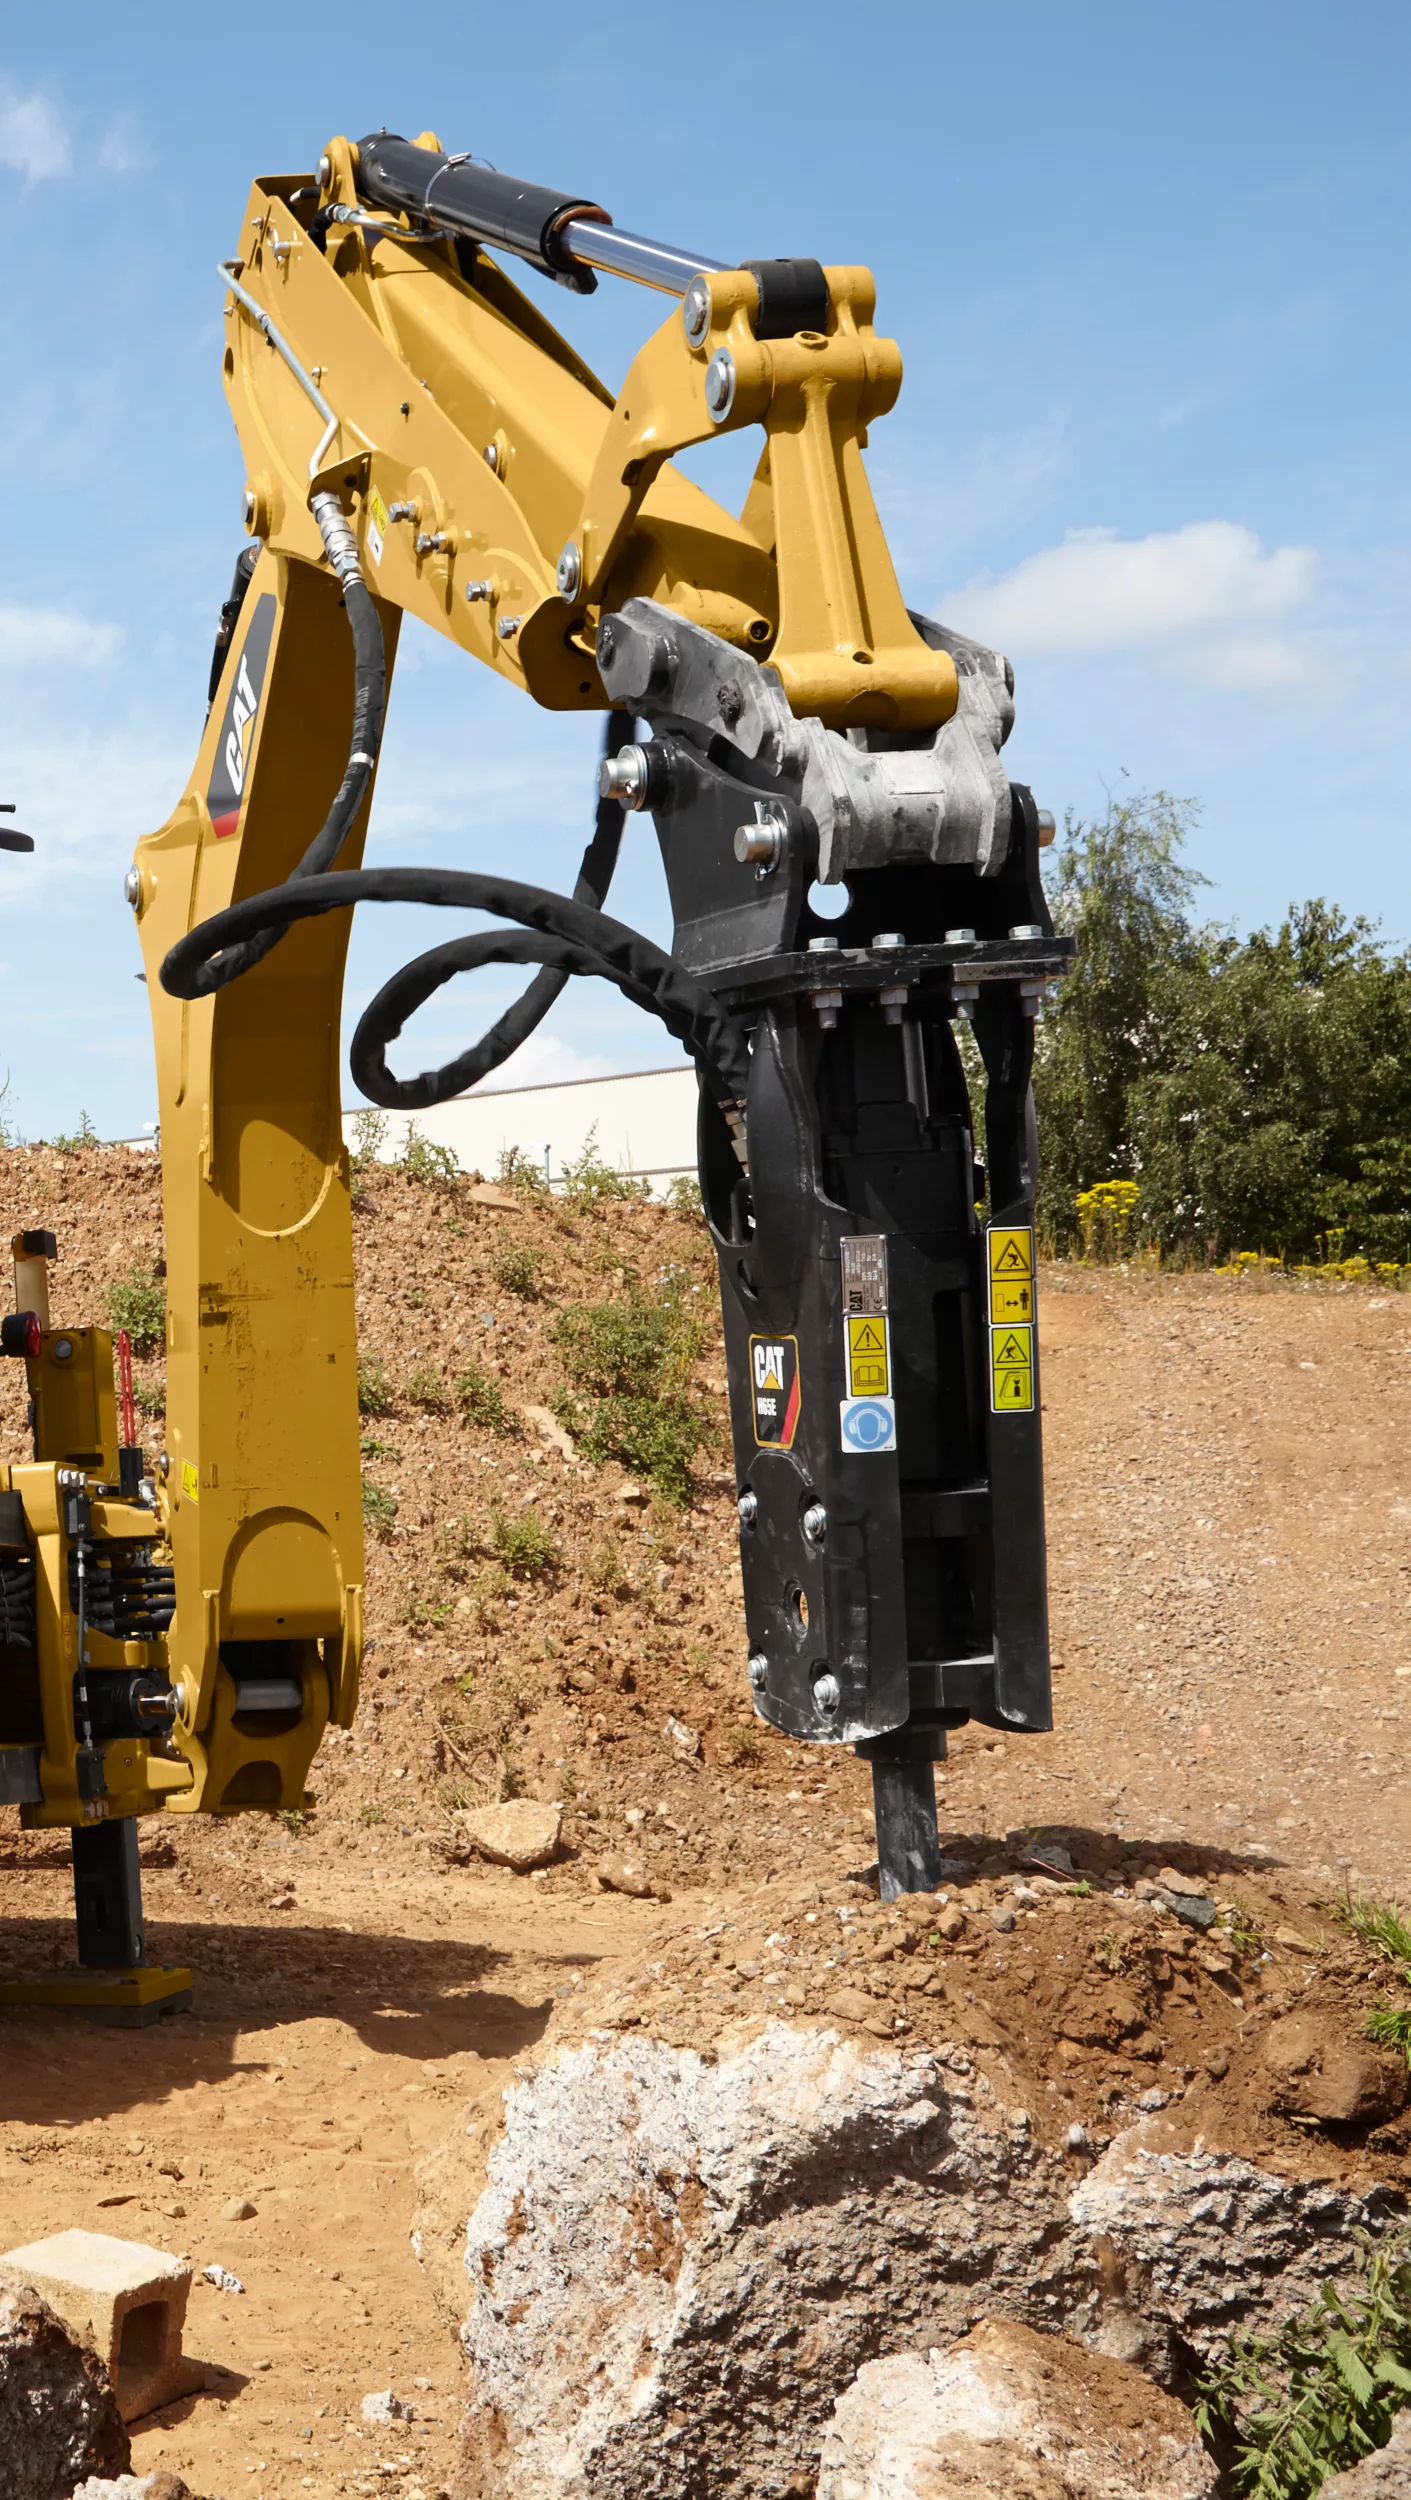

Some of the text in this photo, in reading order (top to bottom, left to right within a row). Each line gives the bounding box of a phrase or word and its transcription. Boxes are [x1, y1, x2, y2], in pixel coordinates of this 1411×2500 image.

[226, 654, 257, 795] CAT
[849, 1290, 863, 1311] CAT
[754, 1345, 784, 1390] CAT
[757, 1397, 777, 1416] H65E
